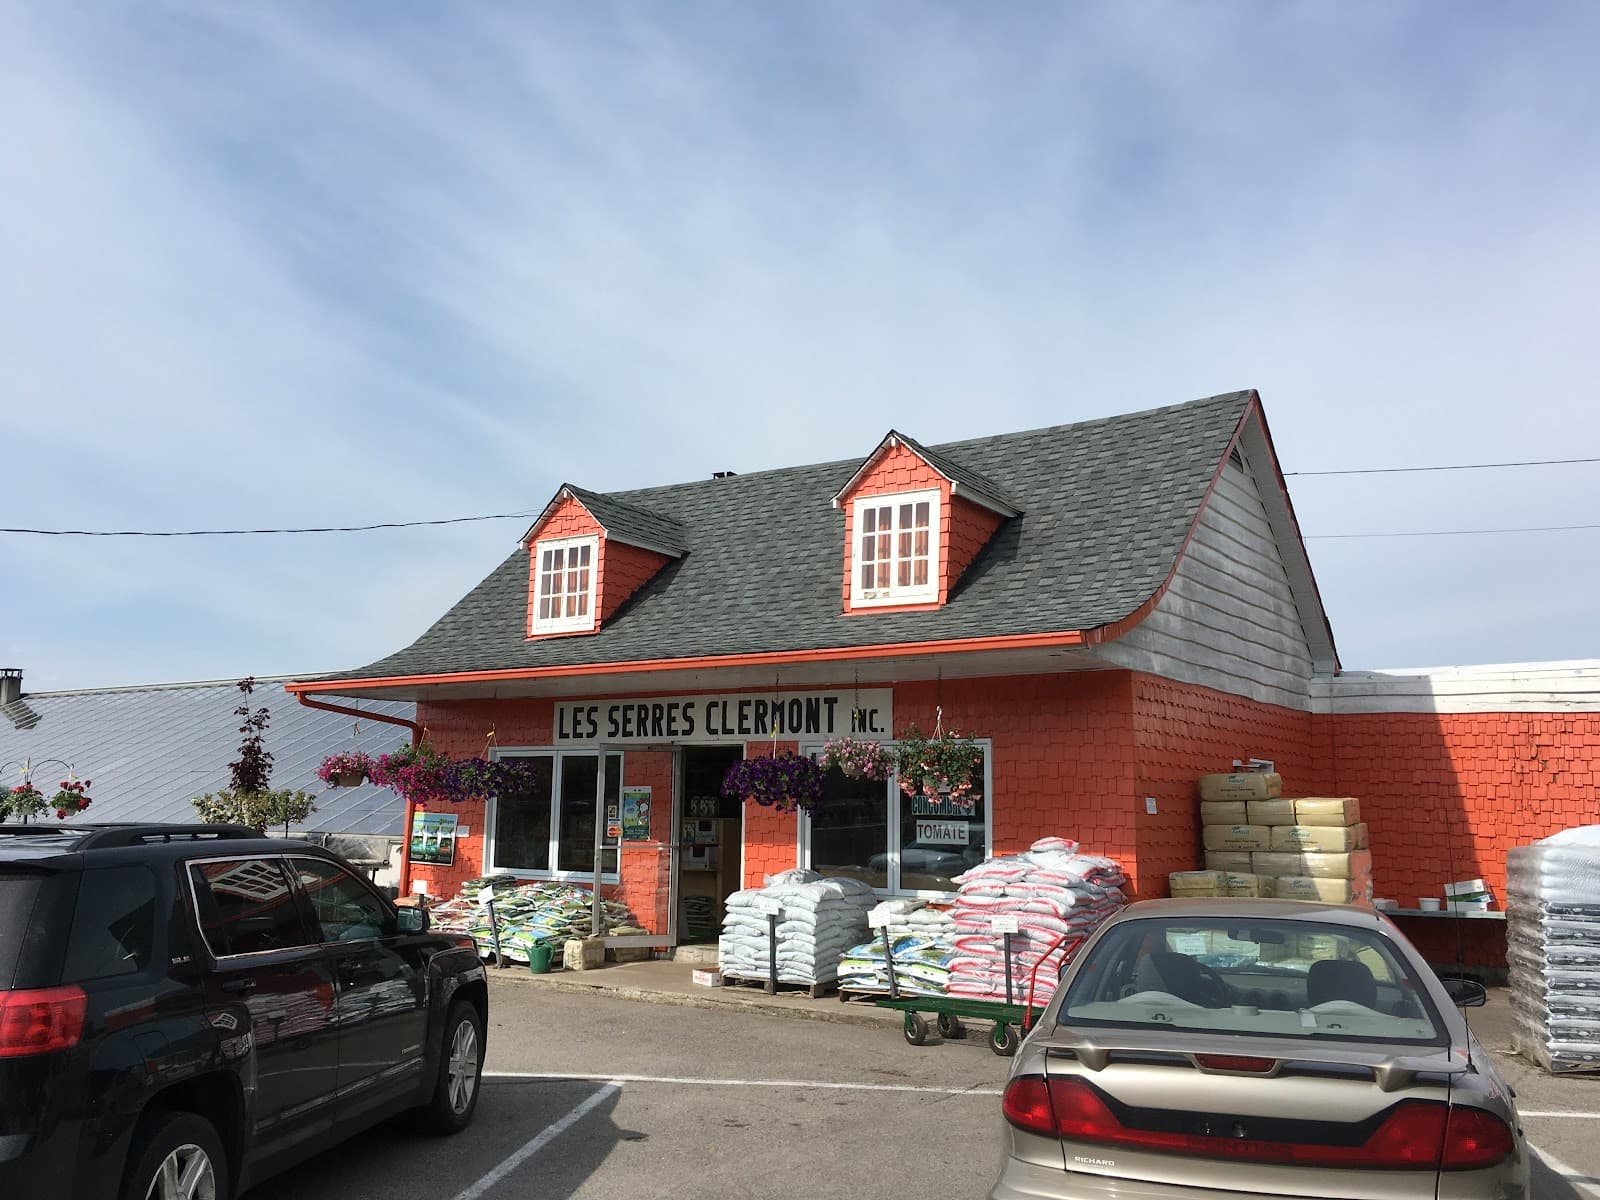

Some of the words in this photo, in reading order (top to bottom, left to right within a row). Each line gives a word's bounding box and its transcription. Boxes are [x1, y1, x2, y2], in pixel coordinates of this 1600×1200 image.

[558, 706, 599, 740] LES
[607, 702, 696, 738] SERRES
[705, 696, 839, 736] CLERMONT
[851, 707, 886, 733] INC.
[917, 823, 967, 840] TOMATE
[1074, 1156, 1115, 1167] RICHARD
